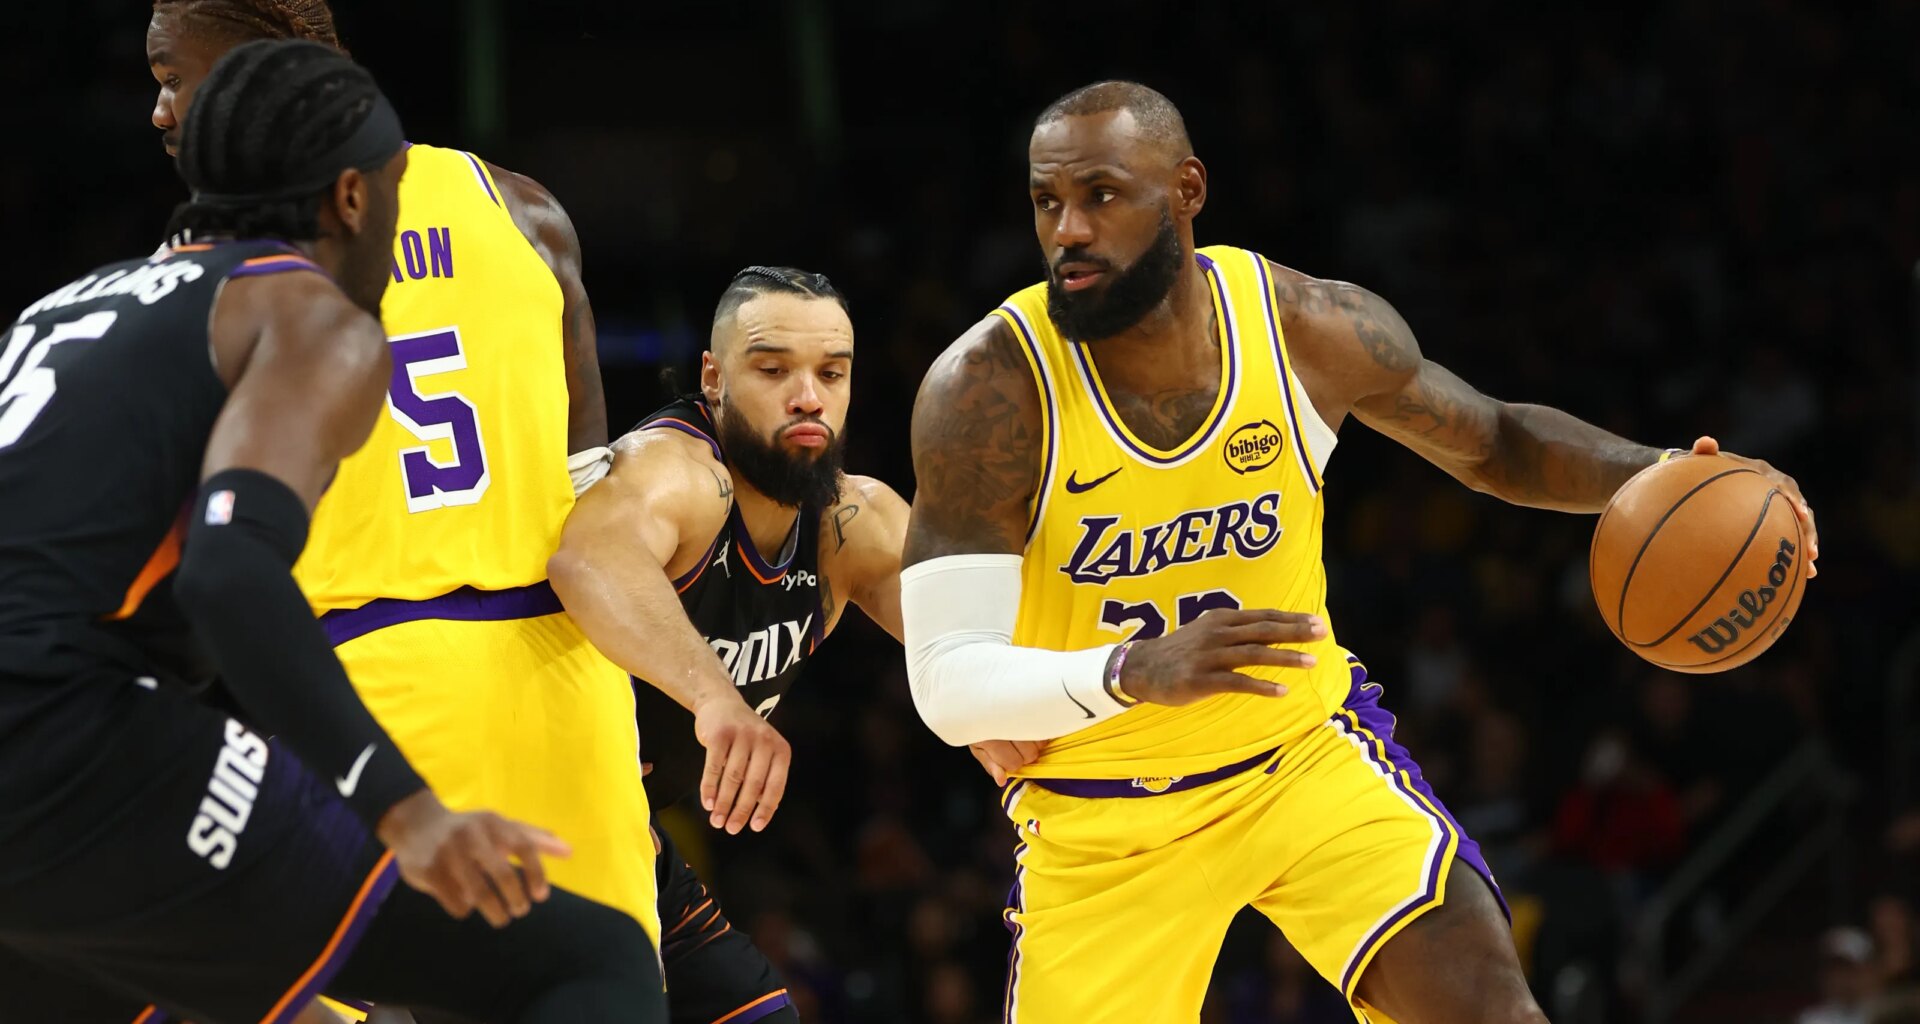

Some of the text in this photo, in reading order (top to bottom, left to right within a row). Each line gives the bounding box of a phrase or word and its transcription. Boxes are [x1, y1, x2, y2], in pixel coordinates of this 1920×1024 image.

[391, 227, 454, 283] ON
[384, 325, 491, 514] 5
[1229, 434, 1279, 458] bibigo
[1239, 451, 1261, 463] 비비고
[1058, 490, 1285, 587] LAKERS
[1687, 537, 1796, 654] Wilson
[186, 717, 269, 870] SUNS
